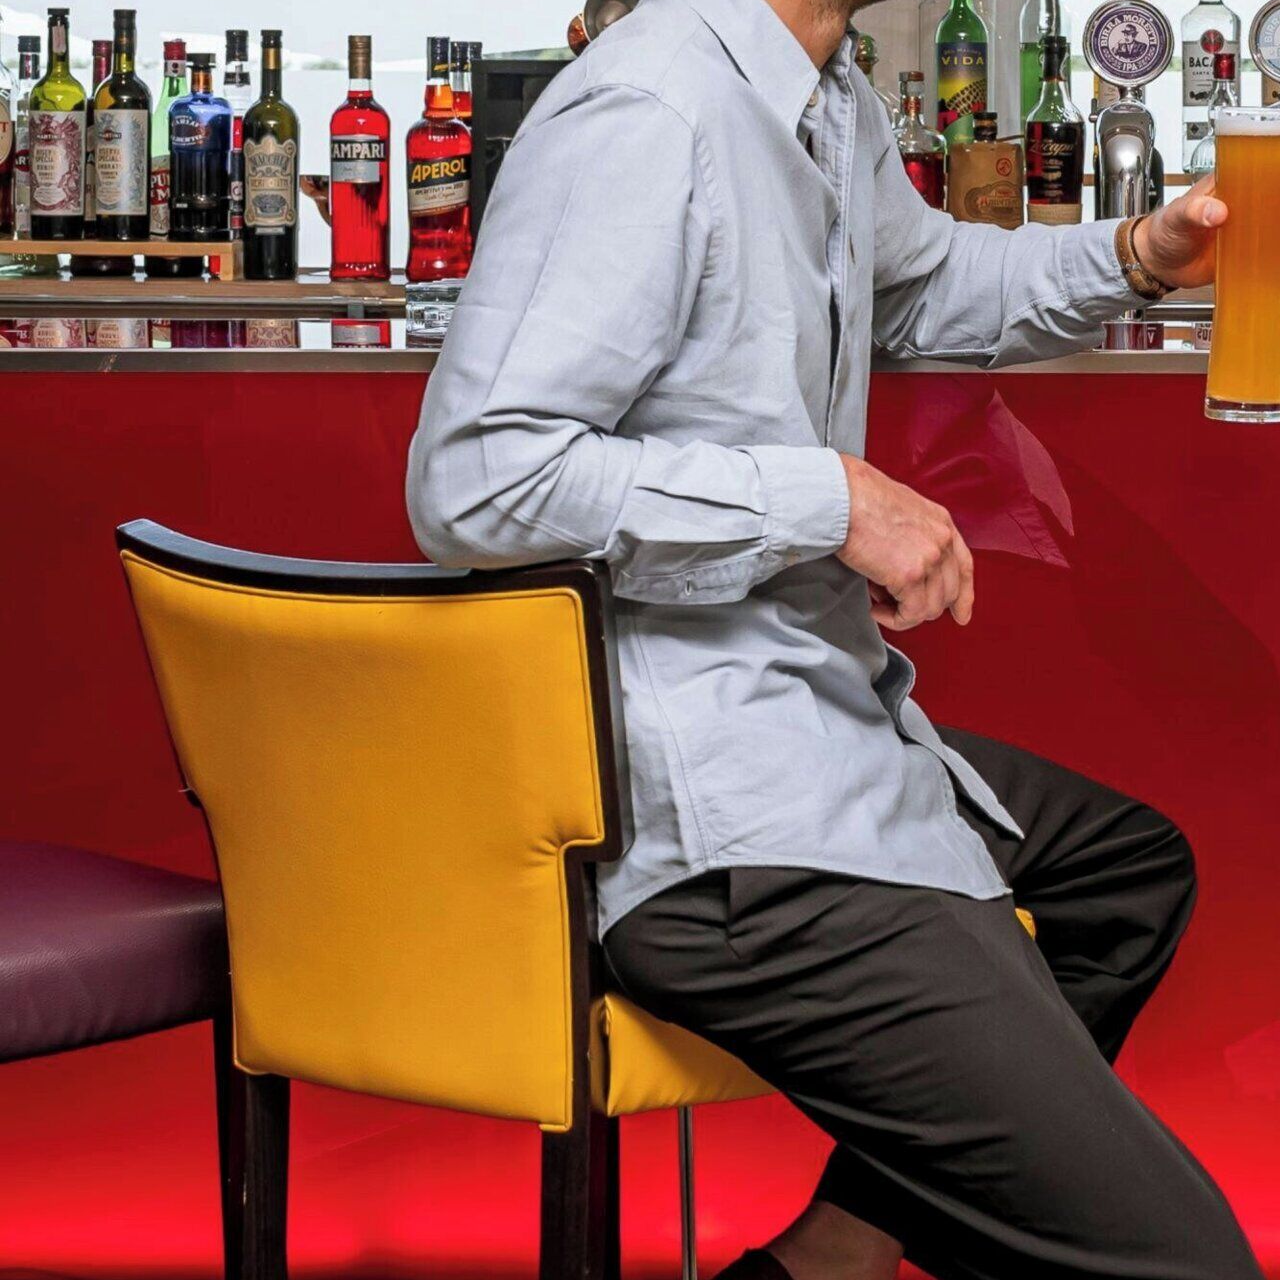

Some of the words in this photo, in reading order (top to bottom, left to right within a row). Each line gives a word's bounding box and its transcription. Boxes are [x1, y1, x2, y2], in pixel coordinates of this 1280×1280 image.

[1101, 18, 1121, 47] BIRRA
[1123, 15, 1157, 45] MORETTI
[941, 56, 984, 65] VIDA
[1189, 57, 1212, 68] BAC
[1122, 62, 1138, 71] IPA
[411, 157, 467, 183] APEROL
